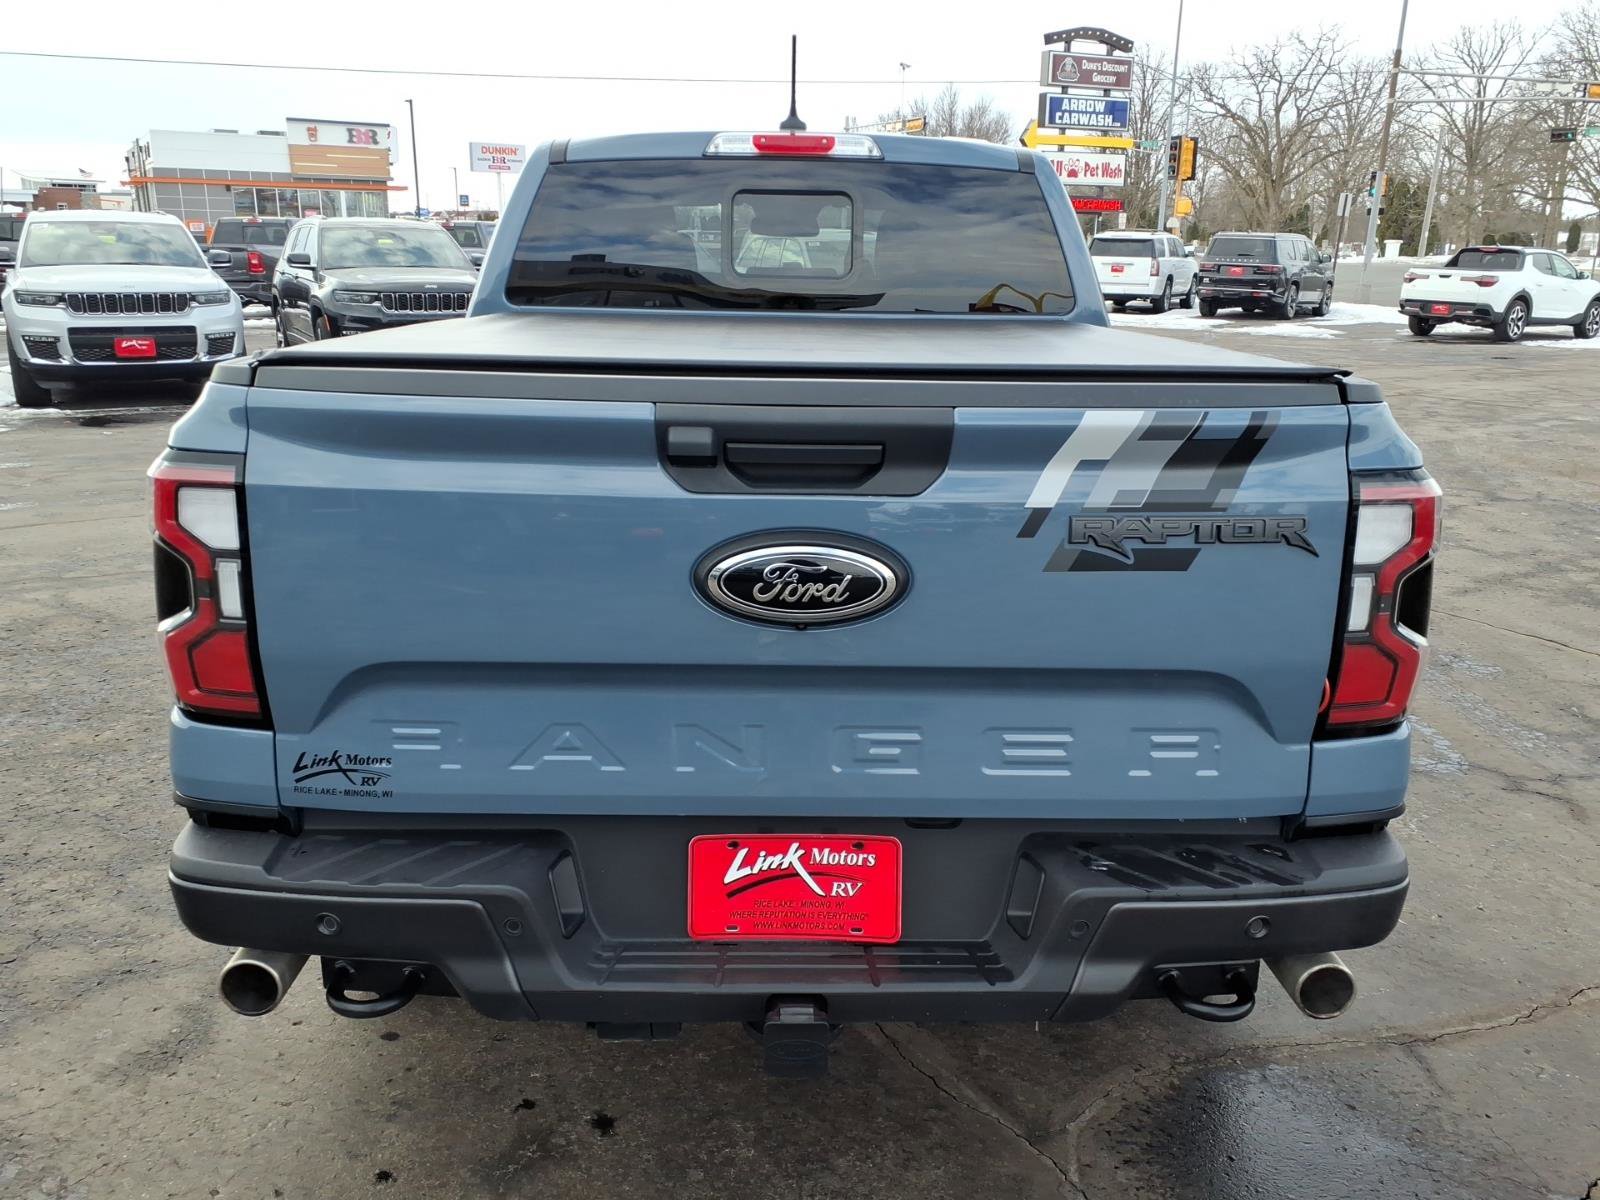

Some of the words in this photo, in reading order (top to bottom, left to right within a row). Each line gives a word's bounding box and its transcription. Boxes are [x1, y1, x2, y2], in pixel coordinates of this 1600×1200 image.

[1102, 62, 1128, 72] DISCOUNT
[1061, 98, 1105, 112] ARROW
[481, 146, 519, 156] DUNKIN'
[1084, 162, 1099, 177] Pet
[1101, 162, 1122, 178] Wash
[1069, 515, 1319, 557] RAPTOR
[752, 562, 852, 603] Ford
[293, 750, 357, 785] Link
[345, 754, 392, 766] Motors
[360, 776, 382, 787] RV
[293, 786, 313, 794] RICE
[315, 787, 337, 796] LAKE
[382, 790, 393, 798] WI
[723, 842, 826, 897] Link
[809, 847, 876, 867] Motors
[830, 882, 863, 897] RV
